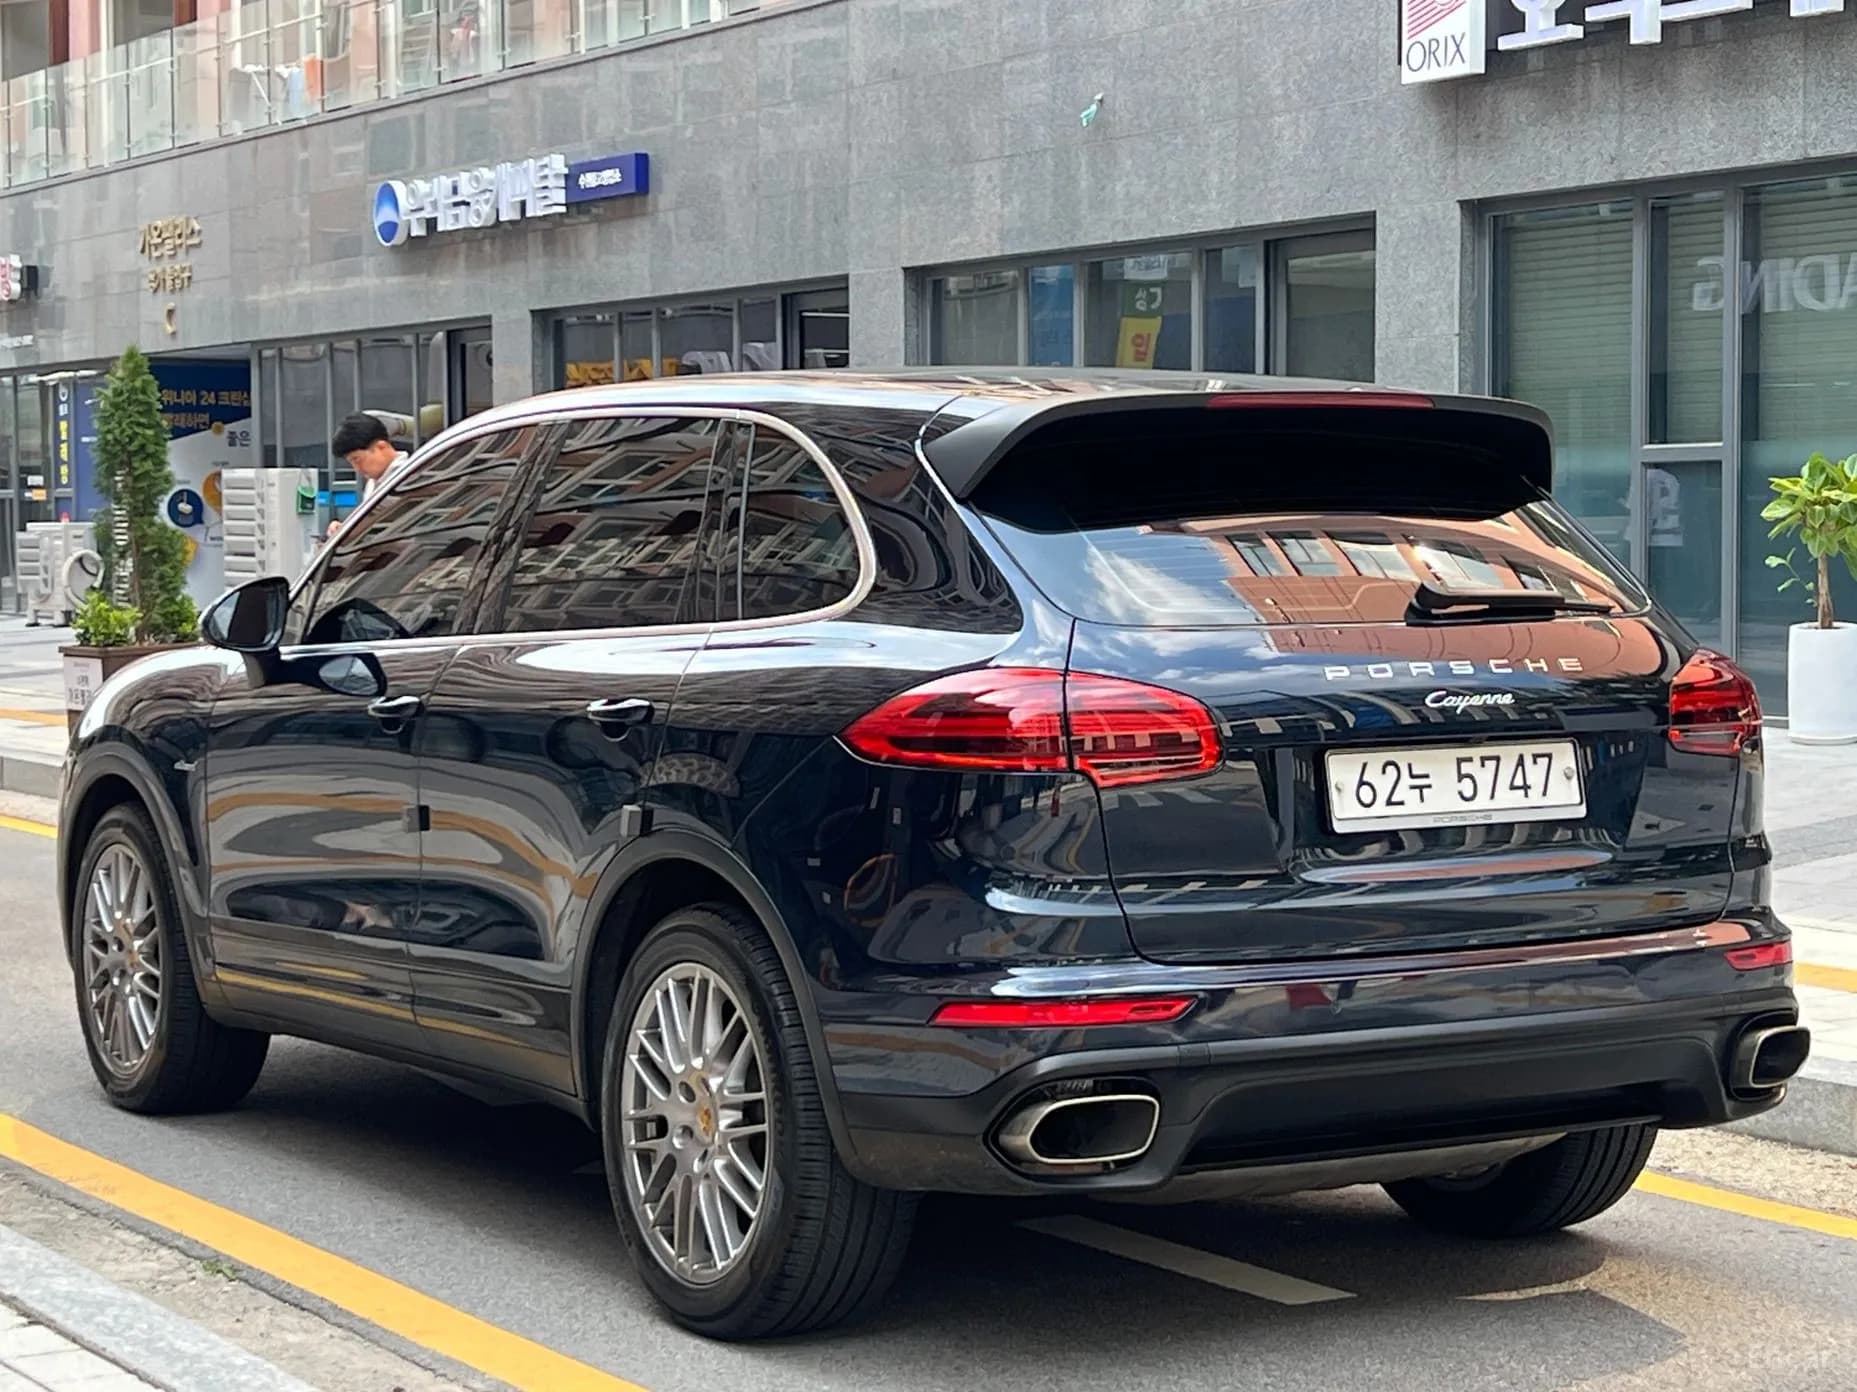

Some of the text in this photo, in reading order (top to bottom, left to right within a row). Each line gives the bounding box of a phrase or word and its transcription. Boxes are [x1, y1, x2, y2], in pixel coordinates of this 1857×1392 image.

[1406, 33, 1466, 73] ORIX
[200, 390, 216, 405] 24
[1323, 657, 1584, 681] PORSCHE
[1425, 690, 1515, 715] Cayenne
[1355, 752, 1554, 809] 62누 5747
